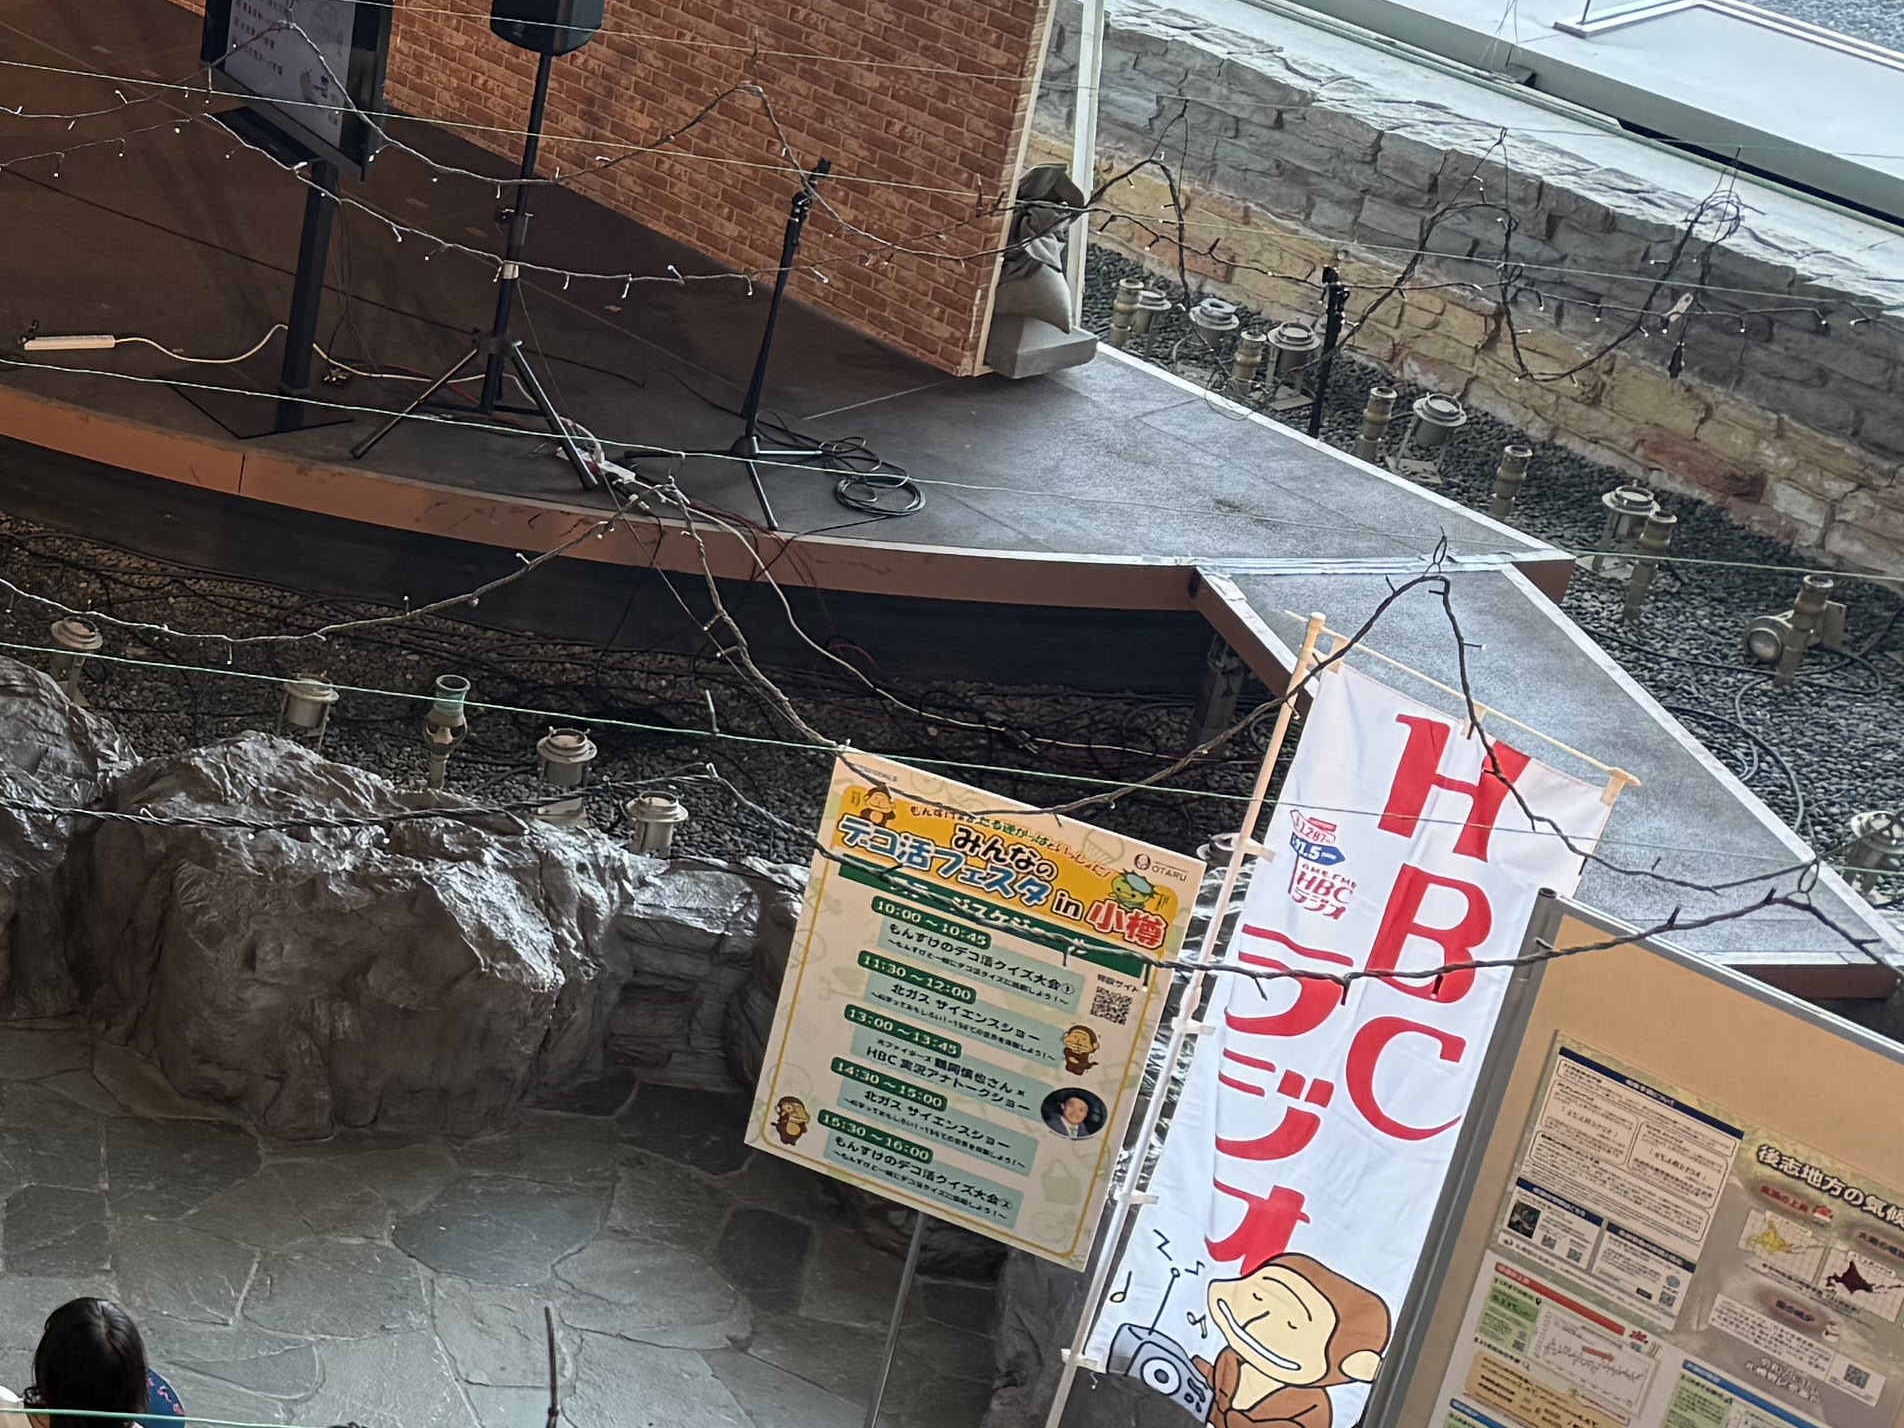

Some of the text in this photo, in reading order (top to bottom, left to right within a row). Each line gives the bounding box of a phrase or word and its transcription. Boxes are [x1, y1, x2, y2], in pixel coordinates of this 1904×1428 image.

[953, 824, 1059, 881] みんなの
[1152, 864, 1187, 881] OTARU
[1297, 871, 1353, 904] HBC
[1053, 888, 1084, 923] in
[1088, 899, 1168, 950] 小樽
[1345, 713, 1531, 1142] HBC
[866, 1047, 896, 1066] HBC
[1204, 924, 1353, 1275] ラジオ
